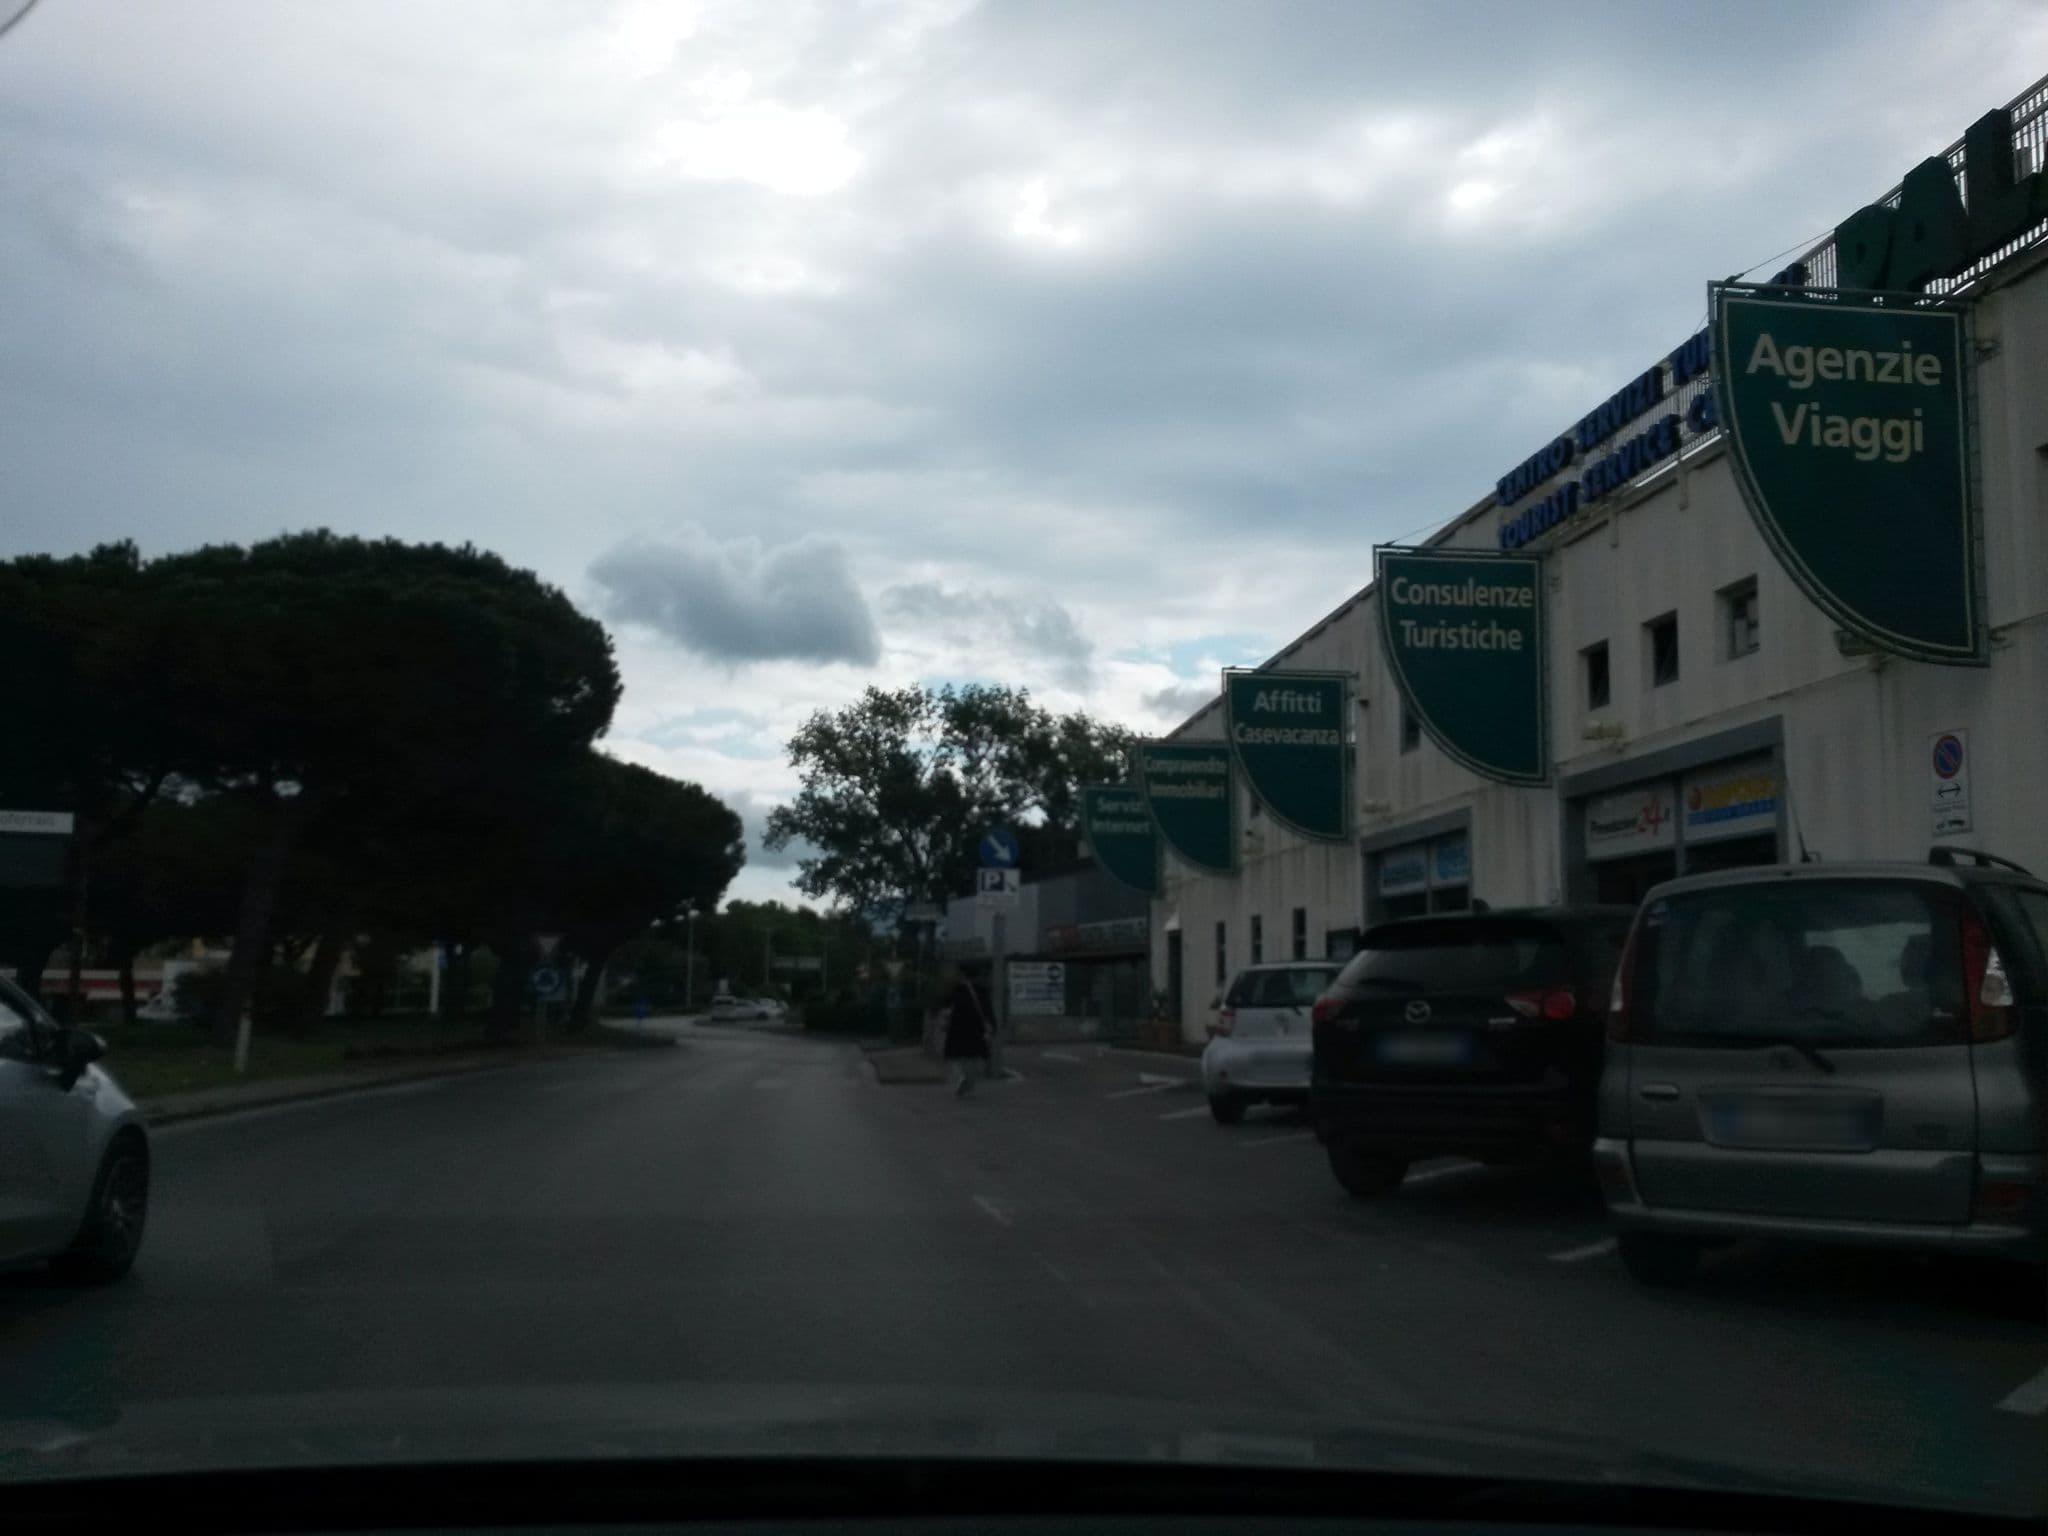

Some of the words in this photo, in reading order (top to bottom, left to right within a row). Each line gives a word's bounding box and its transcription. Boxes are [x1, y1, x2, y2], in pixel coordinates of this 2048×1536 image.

[1745, 333, 1943, 389] Agenzie
[1497, 437, 1575, 507] CENTRO
[1576, 366, 1665, 454] SERVIZI
[1770, 401, 1924, 462] Viaggi
[1497, 481, 1580, 549] TOURIST
[1582, 414, 1681, 505] SERVICE
[1391, 576, 1533, 608] Consulenze
[1399, 618, 1523, 650] Turistiche
[1252, 689, 1323, 713] Affitti
[1233, 721, 1340, 745] Casevacanza
